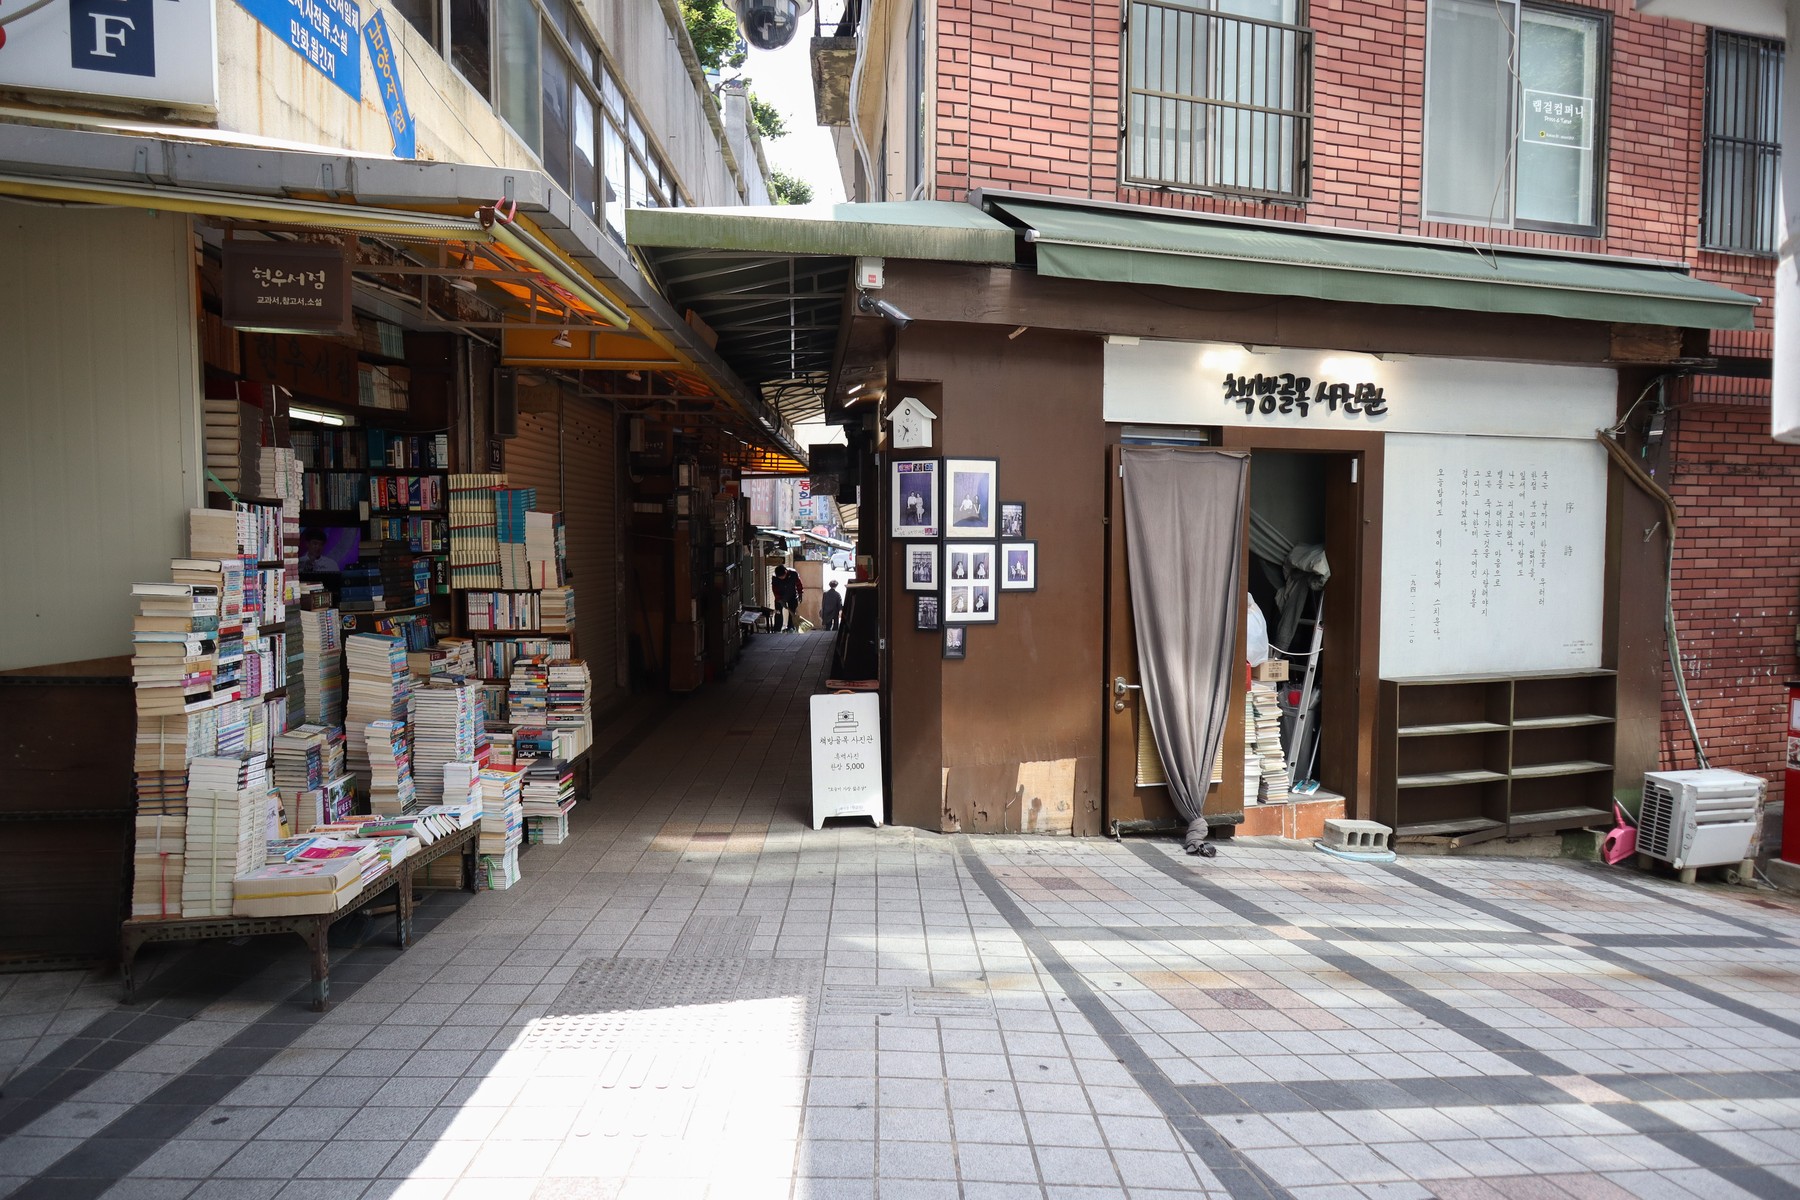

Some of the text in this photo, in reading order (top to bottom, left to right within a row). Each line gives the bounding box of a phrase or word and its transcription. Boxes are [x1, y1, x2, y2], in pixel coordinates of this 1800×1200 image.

[88, 12, 136, 57] F
[290, 19, 335, 78] 만화,월간지
[368, 17, 406, 133] 남양서점
[1532, 99, 1584, 119] 랩걸컴퍼니
[252, 266, 326, 289] 현우서점
[1222, 372, 1389, 418] 책방골목 사진관
[1436, 468, 1445, 516] 오늘밤에도
[1472, 470, 1481, 496] 그리고
[1507, 470, 1515, 489] 나는
[1516, 470, 1526, 577] 잎새에 이는 바람에도
[1538, 470, 1549, 606] 죽는 날까지 하늘을 우러러
[1433, 558, 1442, 588] 바람에
[1493, 549, 1502, 587] 마음으로
[819, 734, 874, 746] 책방골목 사진관
[845, 762, 865, 771] 5,000
